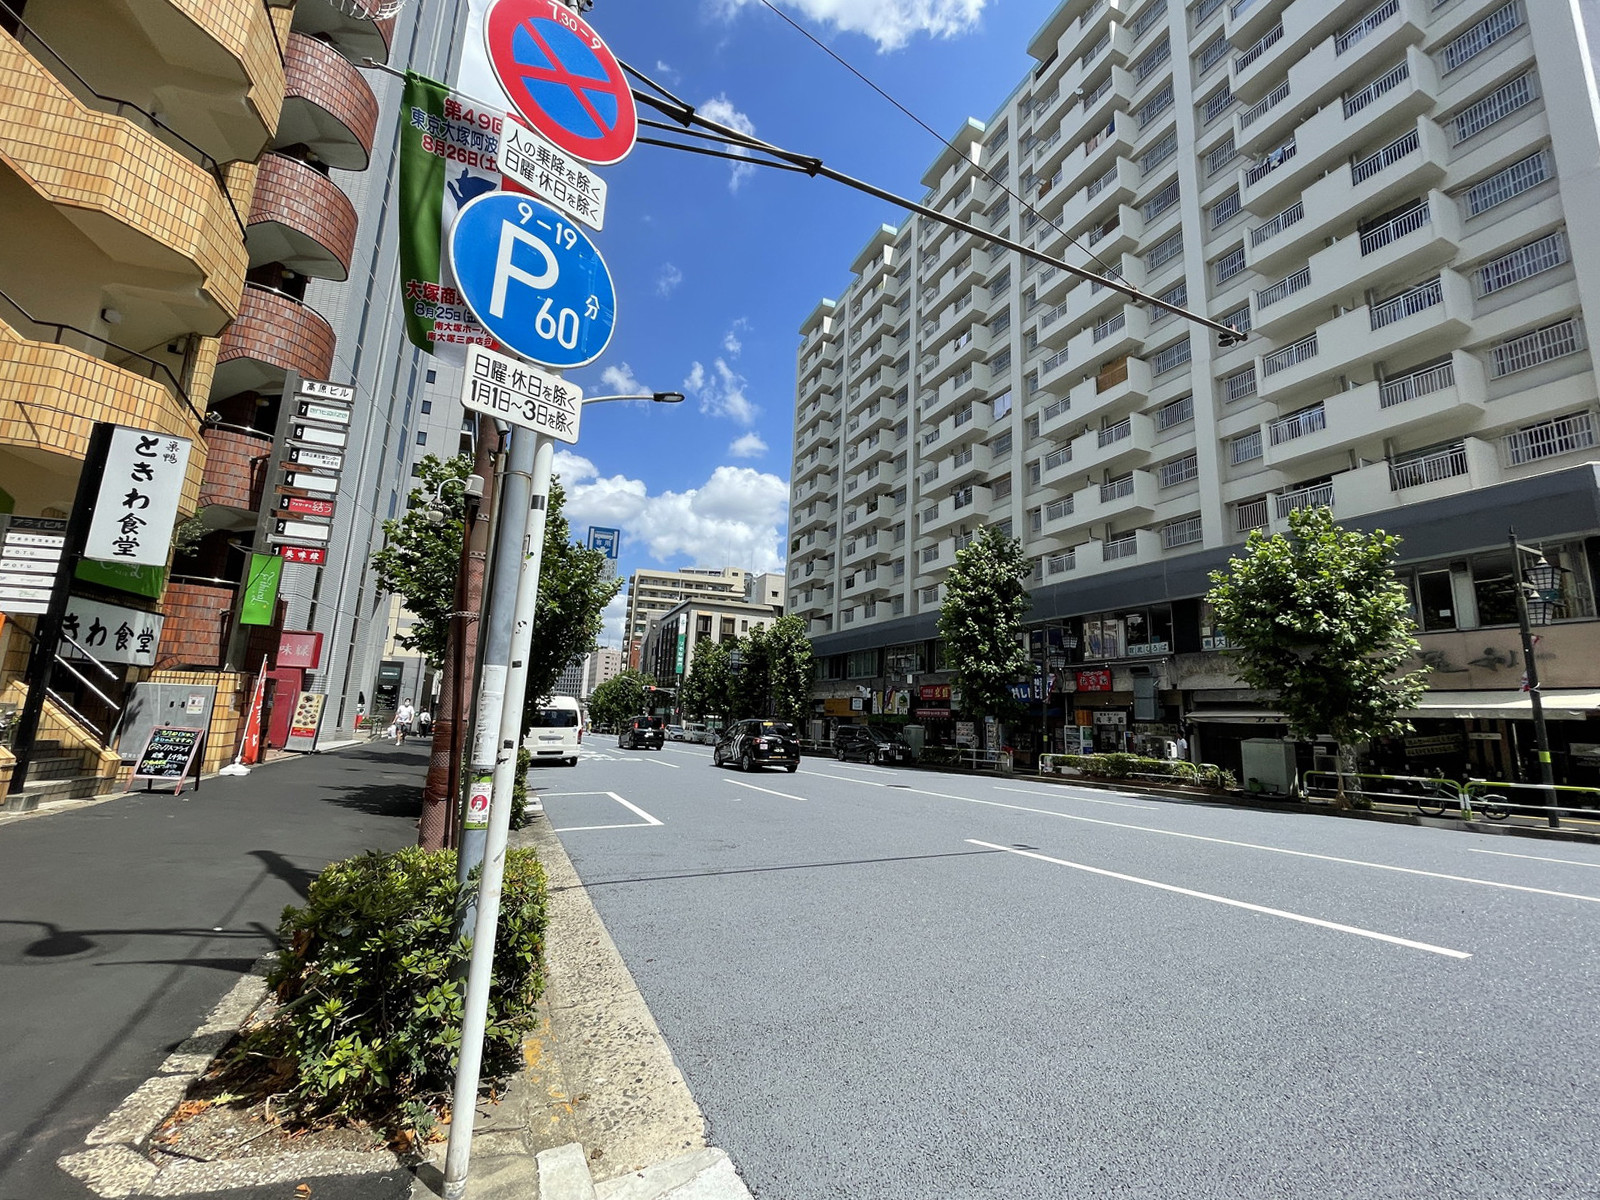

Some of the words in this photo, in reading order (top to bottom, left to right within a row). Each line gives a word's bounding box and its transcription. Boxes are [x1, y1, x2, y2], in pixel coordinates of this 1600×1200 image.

[411, 107, 498, 155] 東京大塚阿波
[506, 129, 600, 201] 人の乗降を除く
[505, 149, 598, 223] 日曜・休日を除く
[517, 202, 578, 251] 9-19
[489, 219, 559, 319] P
[306, 382, 349, 398] 高原ビル
[474, 354, 577, 410] 日曜・休日を除く
[301, 405, 307, 413] 7
[296, 428, 302, 436] 6
[291, 451, 297, 459] 5
[287, 474, 292, 483] 4
[112, 435, 159, 557] ときわ食堂
[282, 499, 289, 507] 3
[278, 522, 284, 531] 2
[274, 547, 280, 555] 1
